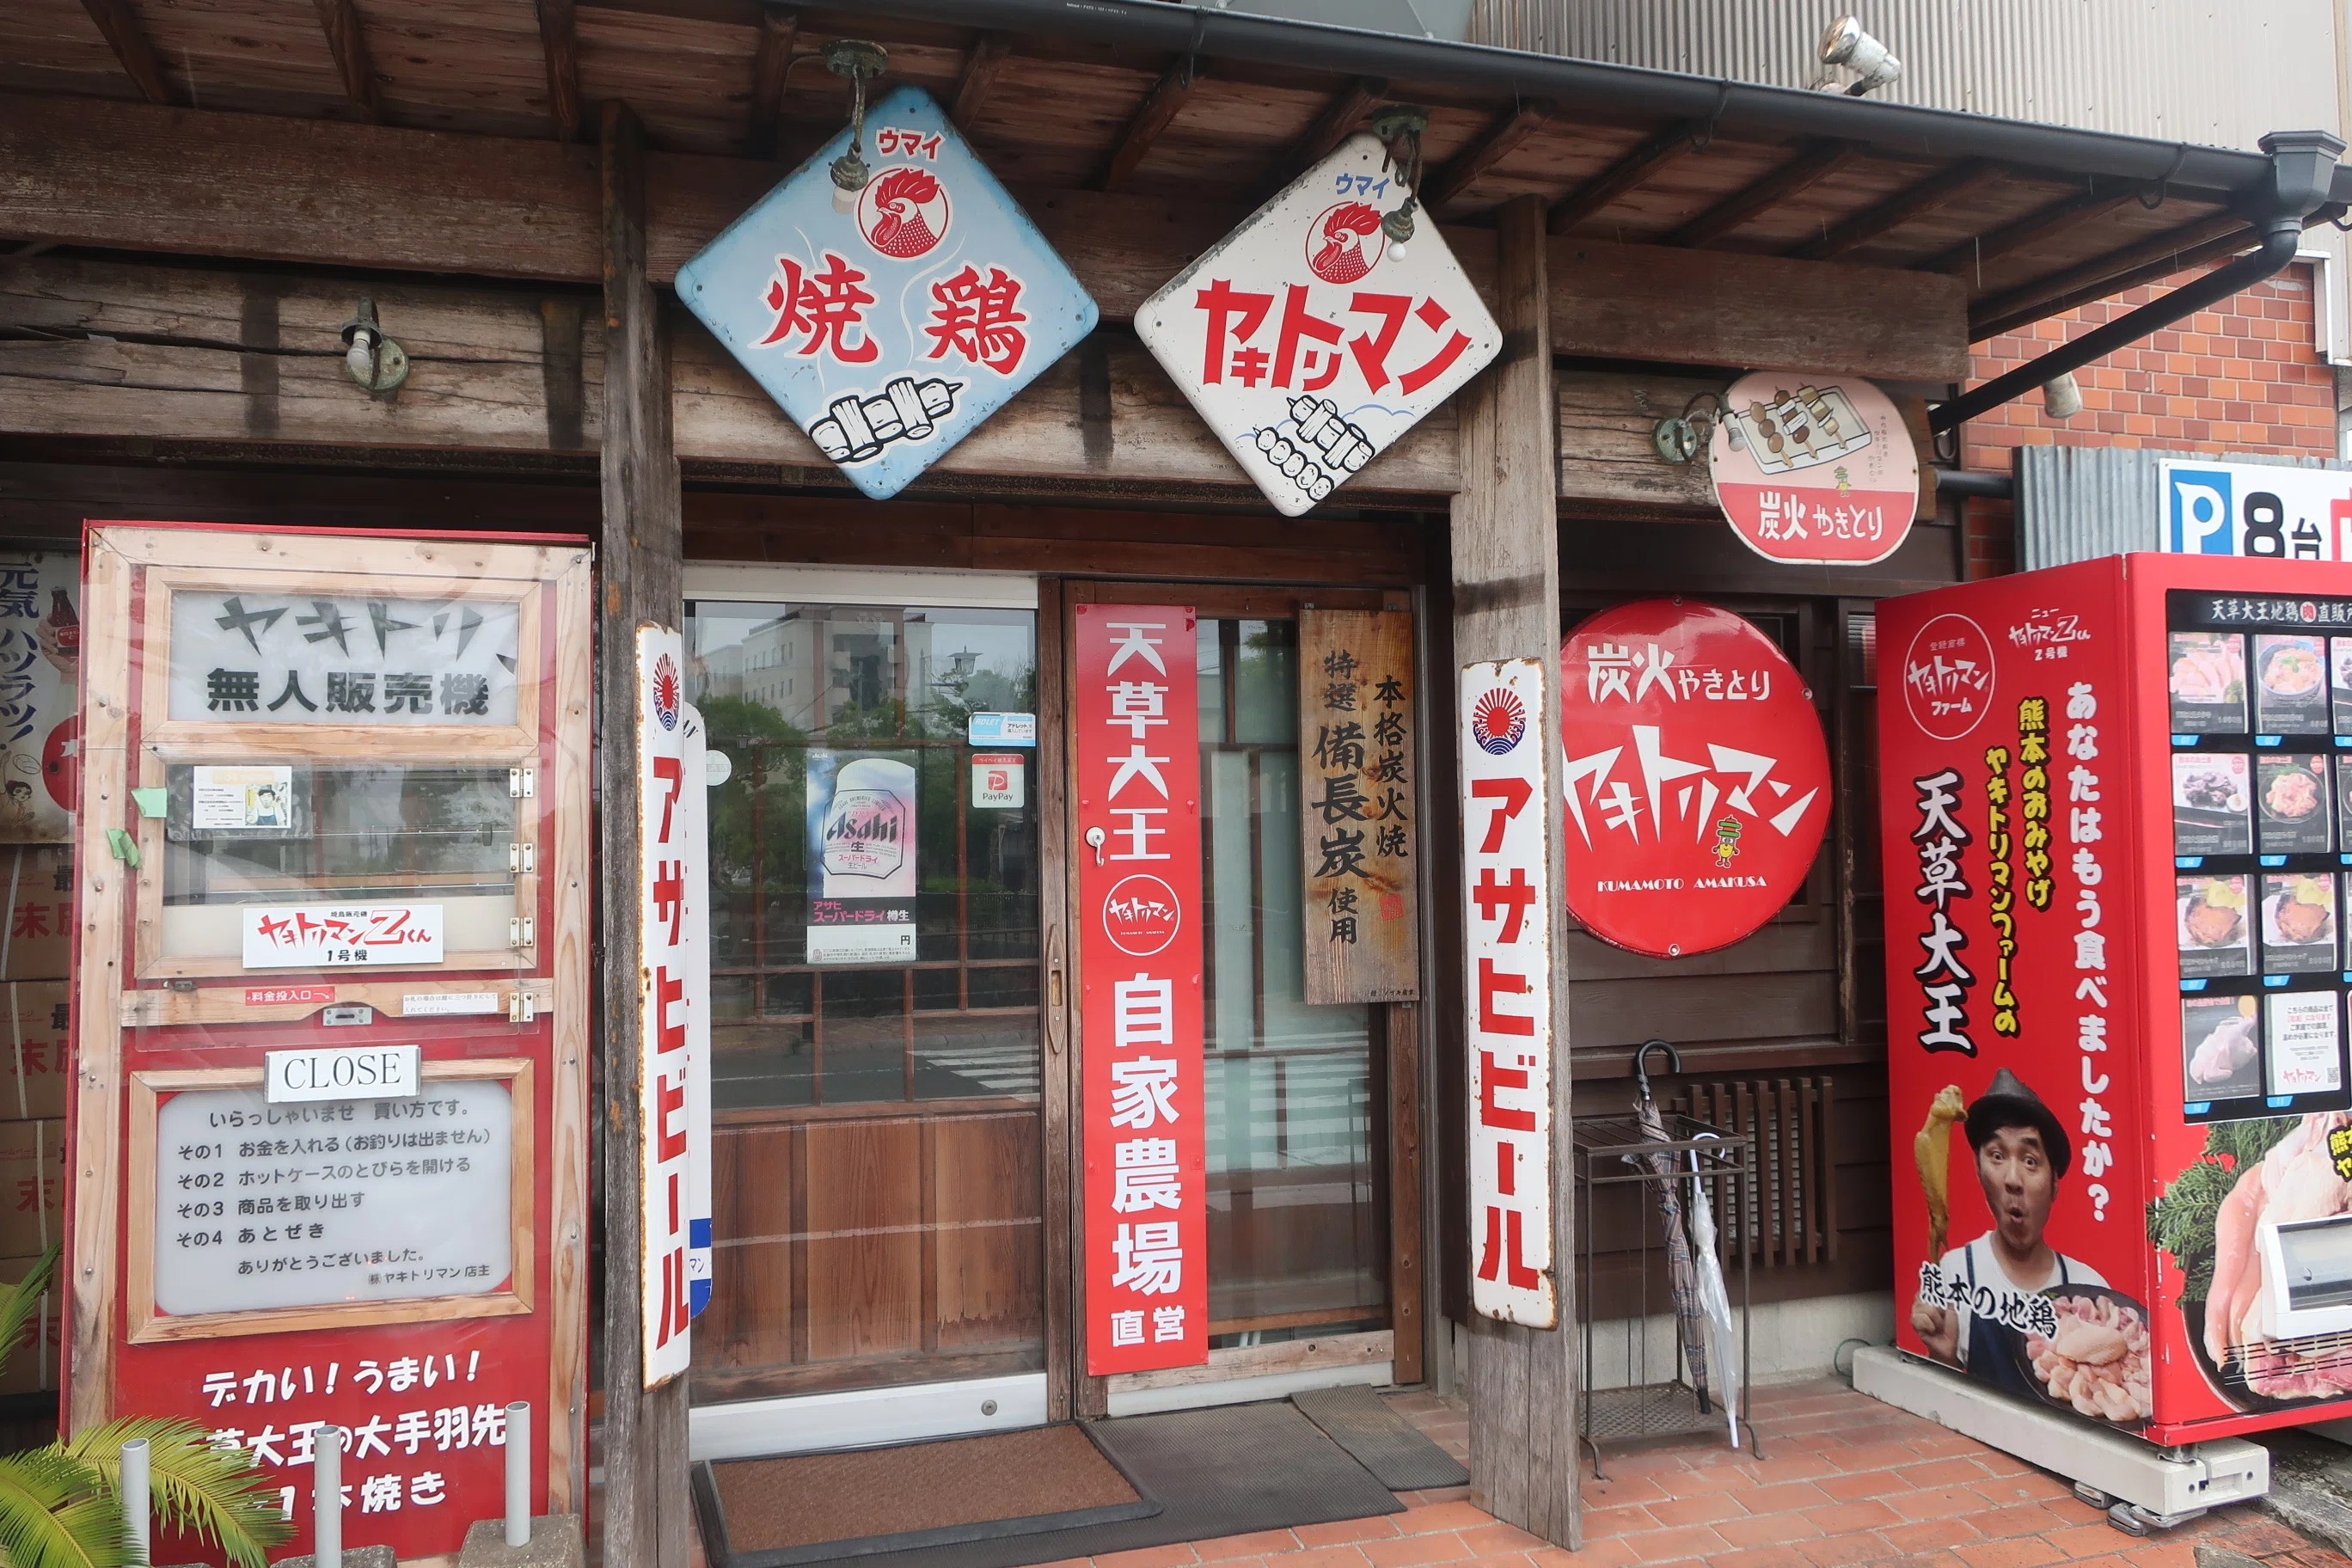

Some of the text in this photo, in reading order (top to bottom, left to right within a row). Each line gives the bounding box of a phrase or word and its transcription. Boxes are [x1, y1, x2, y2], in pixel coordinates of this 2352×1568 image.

[878, 128, 943, 160] ウマイ
[1335, 173, 1389, 199] ウマイ
[1194, 278, 1473, 397] ヤキトリマン
[2030, 608, 2060, 619] ニュー
[2034, 646, 2068, 661] 2号機
[1587, 642, 1771, 704] 炭火やきとり
[1907, 655, 1990, 701] ヤキトリマン
[206, 667, 490, 715] 無人販売機
[1930, 697, 1973, 716] ファーム
[974, 718, 1000, 726] ADLET
[1106, 622, 1172, 861] 天草大王
[1372, 674, 1408, 859] 本格炭火焼
[983, 793, 1014, 801] PayPay
[1561, 724, 1820, 854] ヤキトリマン
[2019, 698, 2052, 907] 熊本のおみやげ
[826, 812, 897, 842] Asahi
[838, 854, 879, 864] スーパードライ
[850, 841, 865, 853] 生
[1597, 875, 1767, 892] KUMAMOTO AMAKUSA
[1985, 746, 2018, 1034] ヤキトリマンファームの
[812, 901, 842, 911] アサヒ
[1108, 897, 1175, 925] ヤキトリマン
[1912, 770, 1972, 1050] 天草大王
[900, 934, 911, 946] 円
[2066, 681, 2114, 1223] あなたはもう食べましたか?
[326, 948, 369, 963] 1号機
[250, 989, 312, 1002] 料金投入口
[1471, 777, 1540, 1291] アサヒビール
[653, 755, 689, 1351] アサヒビール
[284, 1052, 402, 1090] CLOSE
[209, 1099, 469, 1129] いらっしゃいませ 買い方です。
[1109, 971, 1183, 1297] 自家農場
[177, 1144, 224, 1161] その1
[177, 1157, 471, 1189] その2 ホットケースのとびらを開ける
[176, 1191, 365, 1219] その3 商品を取り出す
[176, 1222, 325, 1247] その4 あとぜき
[237, 1247, 425, 1276] ありがとうございました。
[1920, 1263, 2058, 1341] 熊本の地鶏
[1111, 1304, 1185, 1347] 直営
